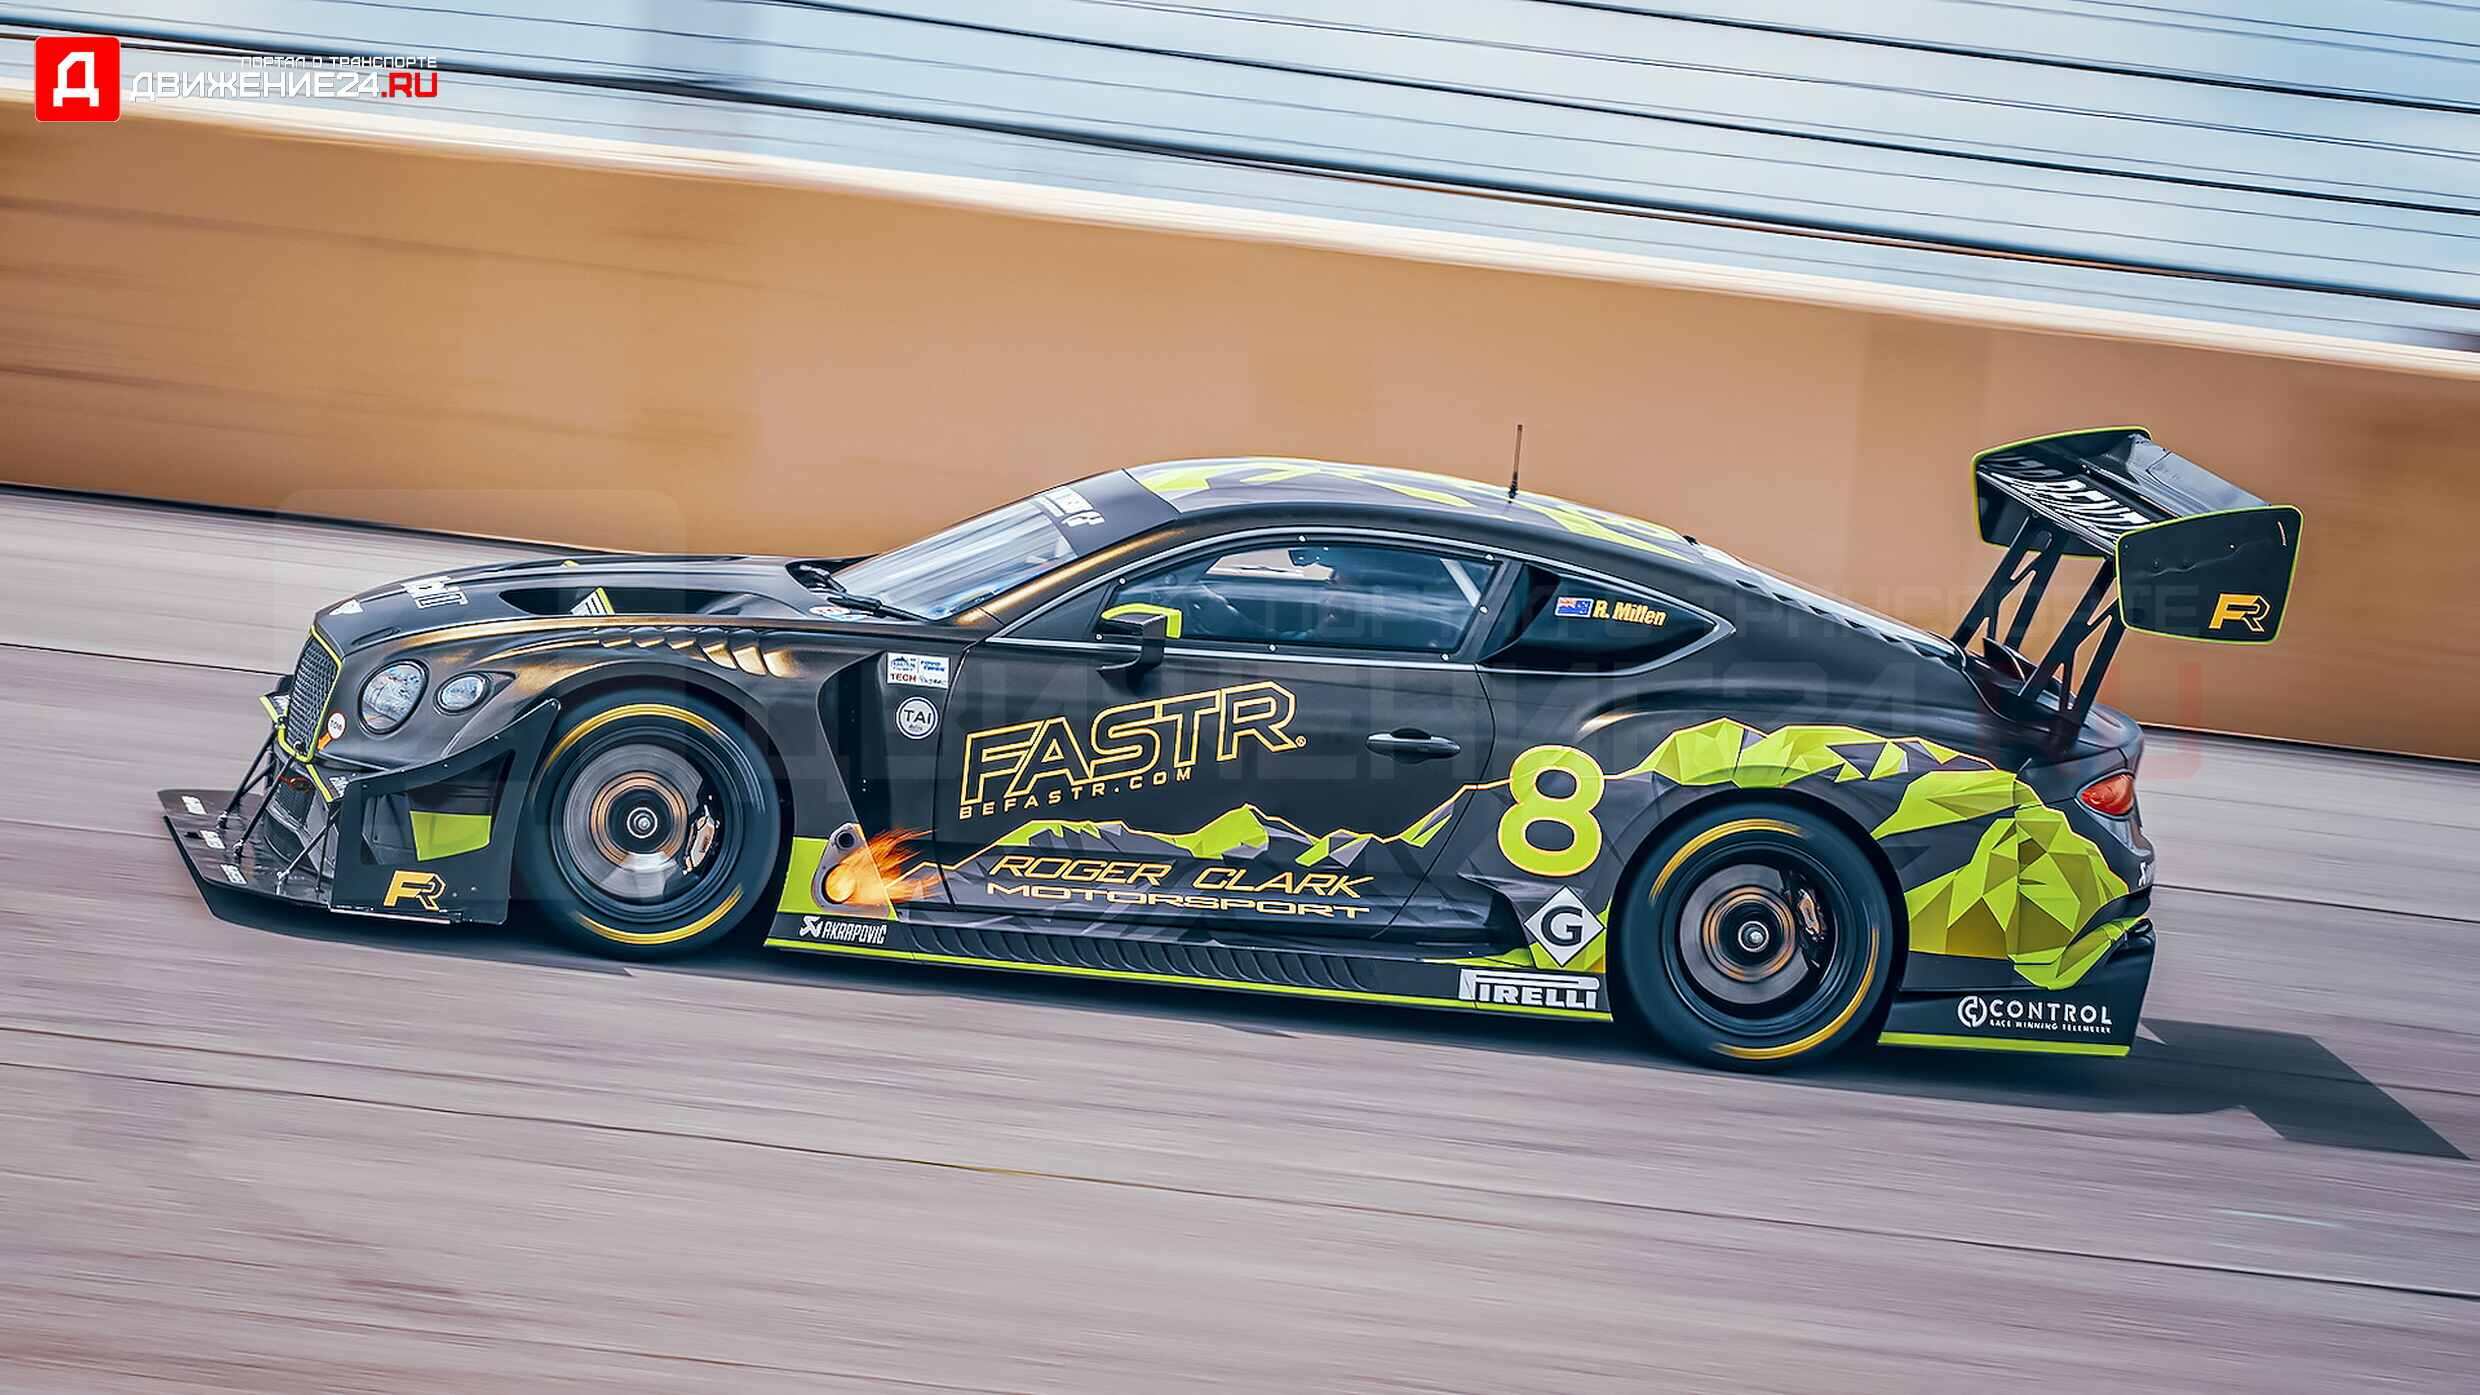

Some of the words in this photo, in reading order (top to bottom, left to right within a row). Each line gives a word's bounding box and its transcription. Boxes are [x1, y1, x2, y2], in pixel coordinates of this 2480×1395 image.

[1592, 600, 1610, 619] R.
[1611, 601, 1667, 626] Millen
[890, 672, 917, 682] TECH
[903, 708, 932, 726] TAI
[959, 767, 1192, 820] BEFASTR.COM
[1498, 745, 1604, 876] 8
[989, 854, 1173, 887] ROGER
[1191, 866, 1375, 899] CLARK
[987, 882, 1371, 920] MOTORSPORT
[1540, 906, 1583, 946] G
[1459, 967, 1601, 1010] PIRELLI
[1989, 999, 2112, 1024] CONTROL
